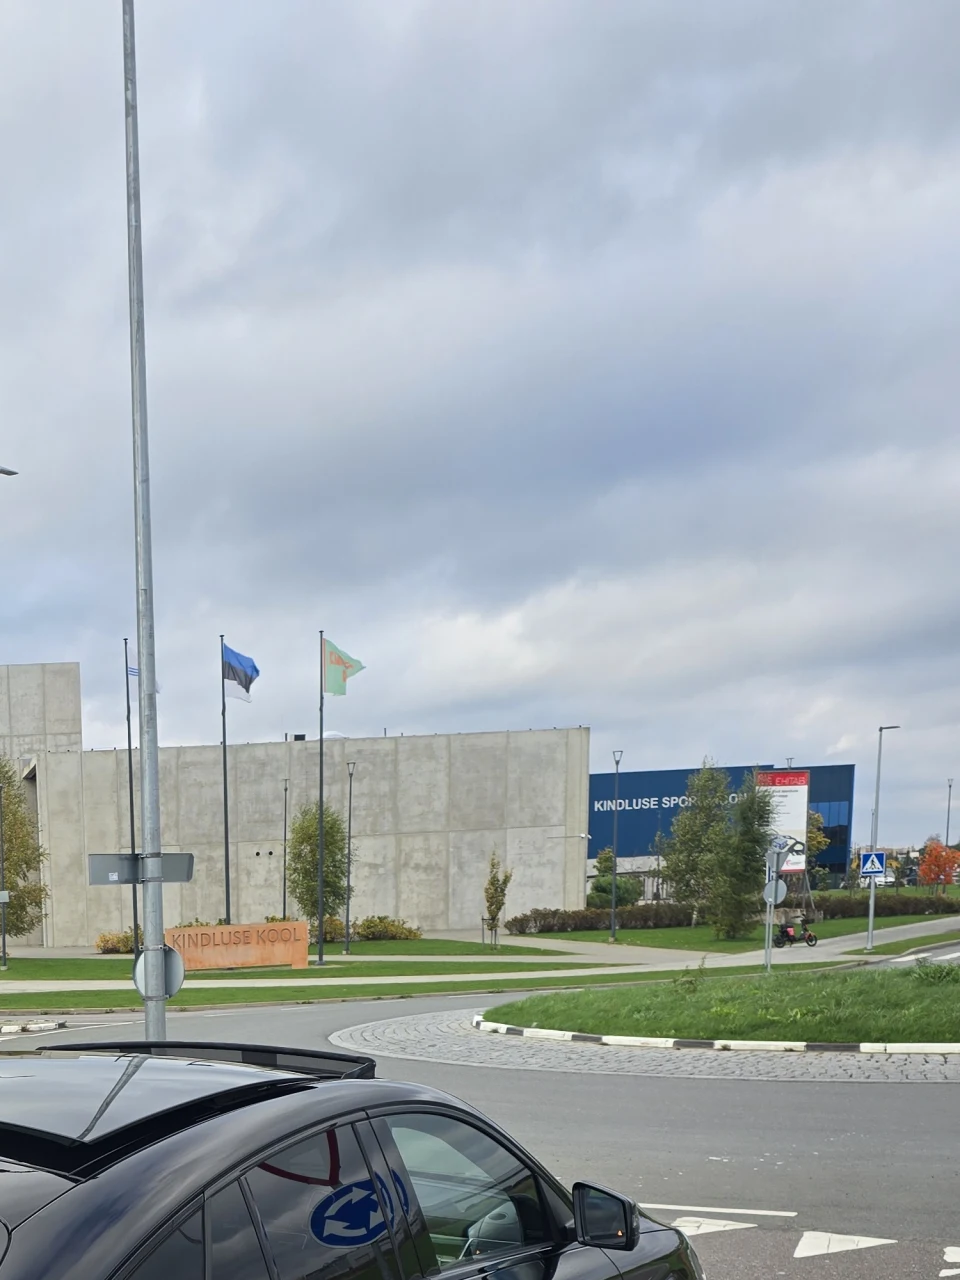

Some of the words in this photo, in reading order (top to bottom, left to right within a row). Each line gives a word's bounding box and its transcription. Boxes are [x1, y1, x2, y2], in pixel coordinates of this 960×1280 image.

[594, 797, 658, 811] KINDLUSE
[172, 930, 251, 948] KINDLUSE
[256, 927, 301, 945] KOOL
